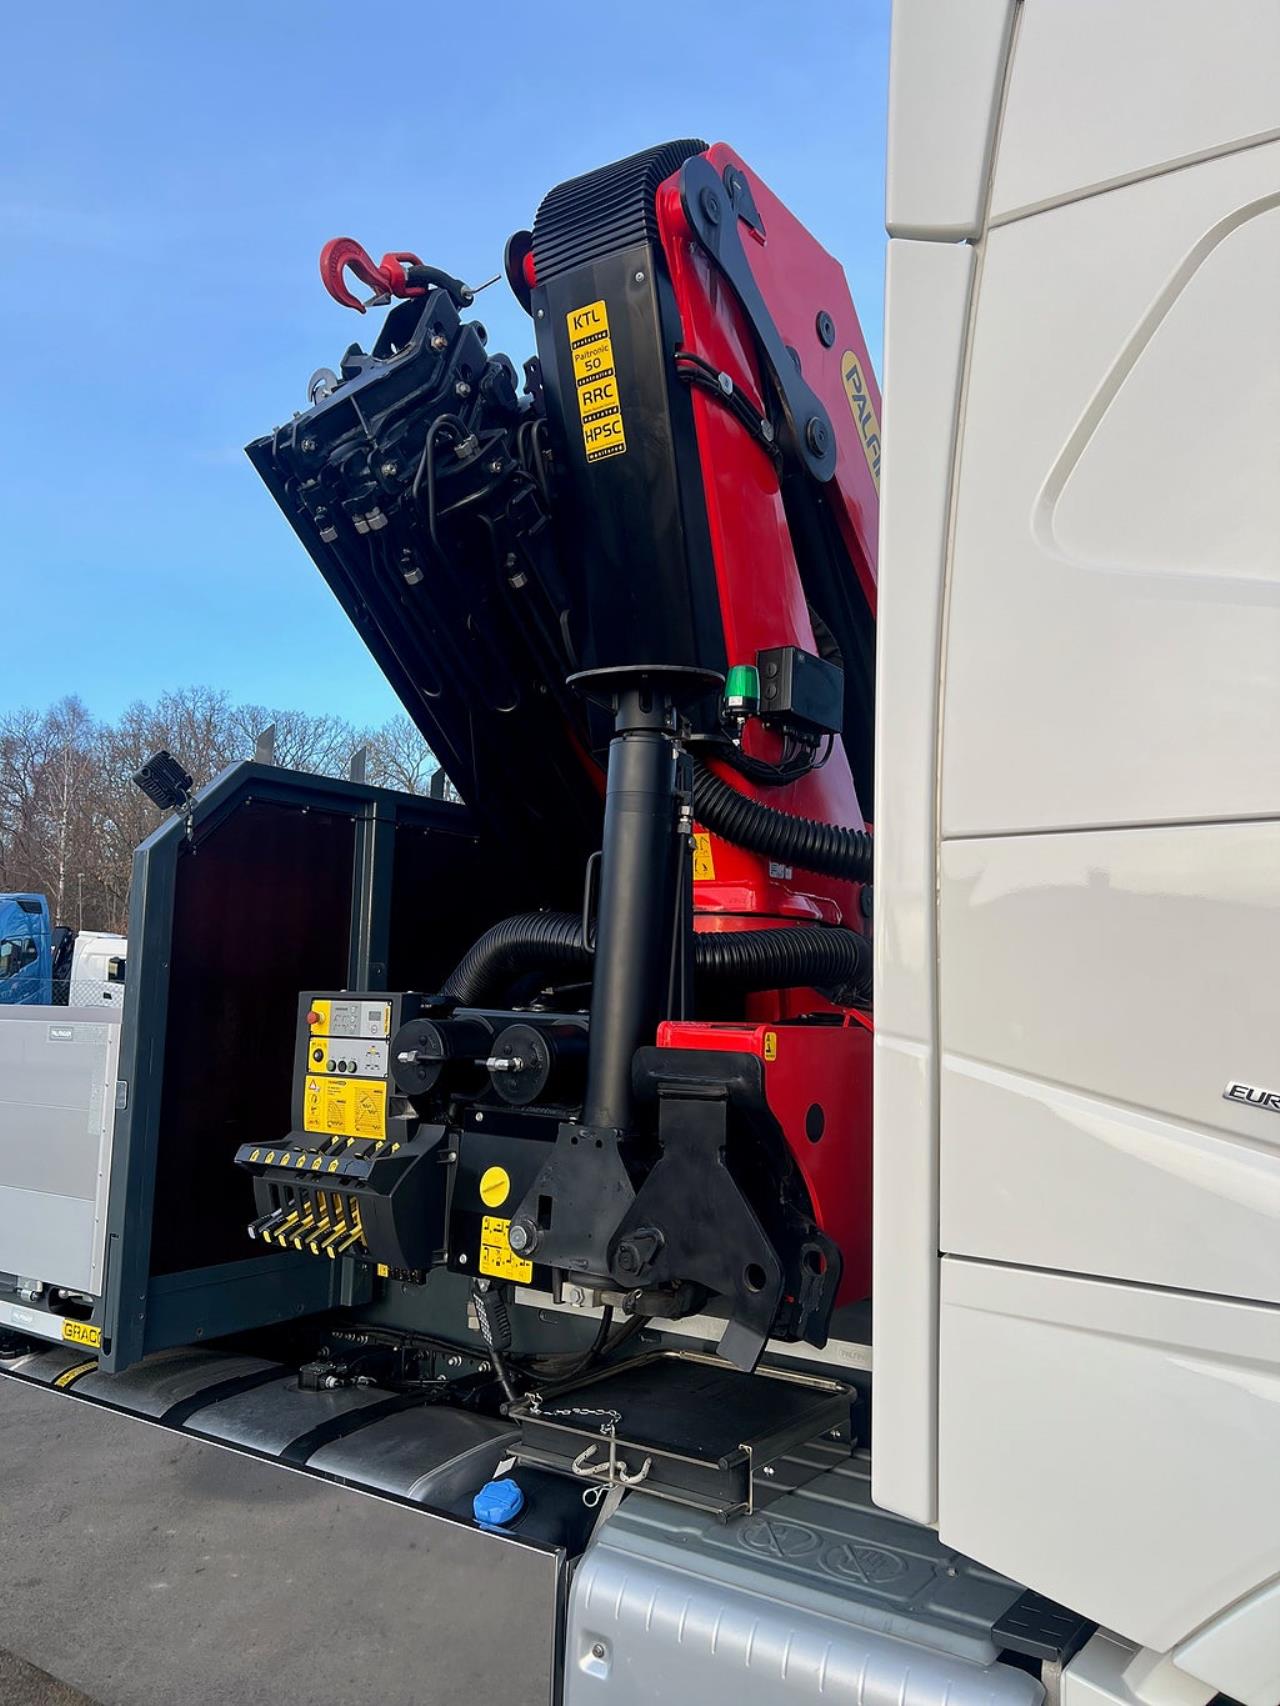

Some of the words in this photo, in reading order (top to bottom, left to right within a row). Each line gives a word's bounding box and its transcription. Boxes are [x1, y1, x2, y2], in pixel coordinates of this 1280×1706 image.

[574, 309, 600, 330] KTL
[584, 357, 602, 372] 50
[582, 383, 613, 406] RRC
[585, 420, 621, 444] HPSC
